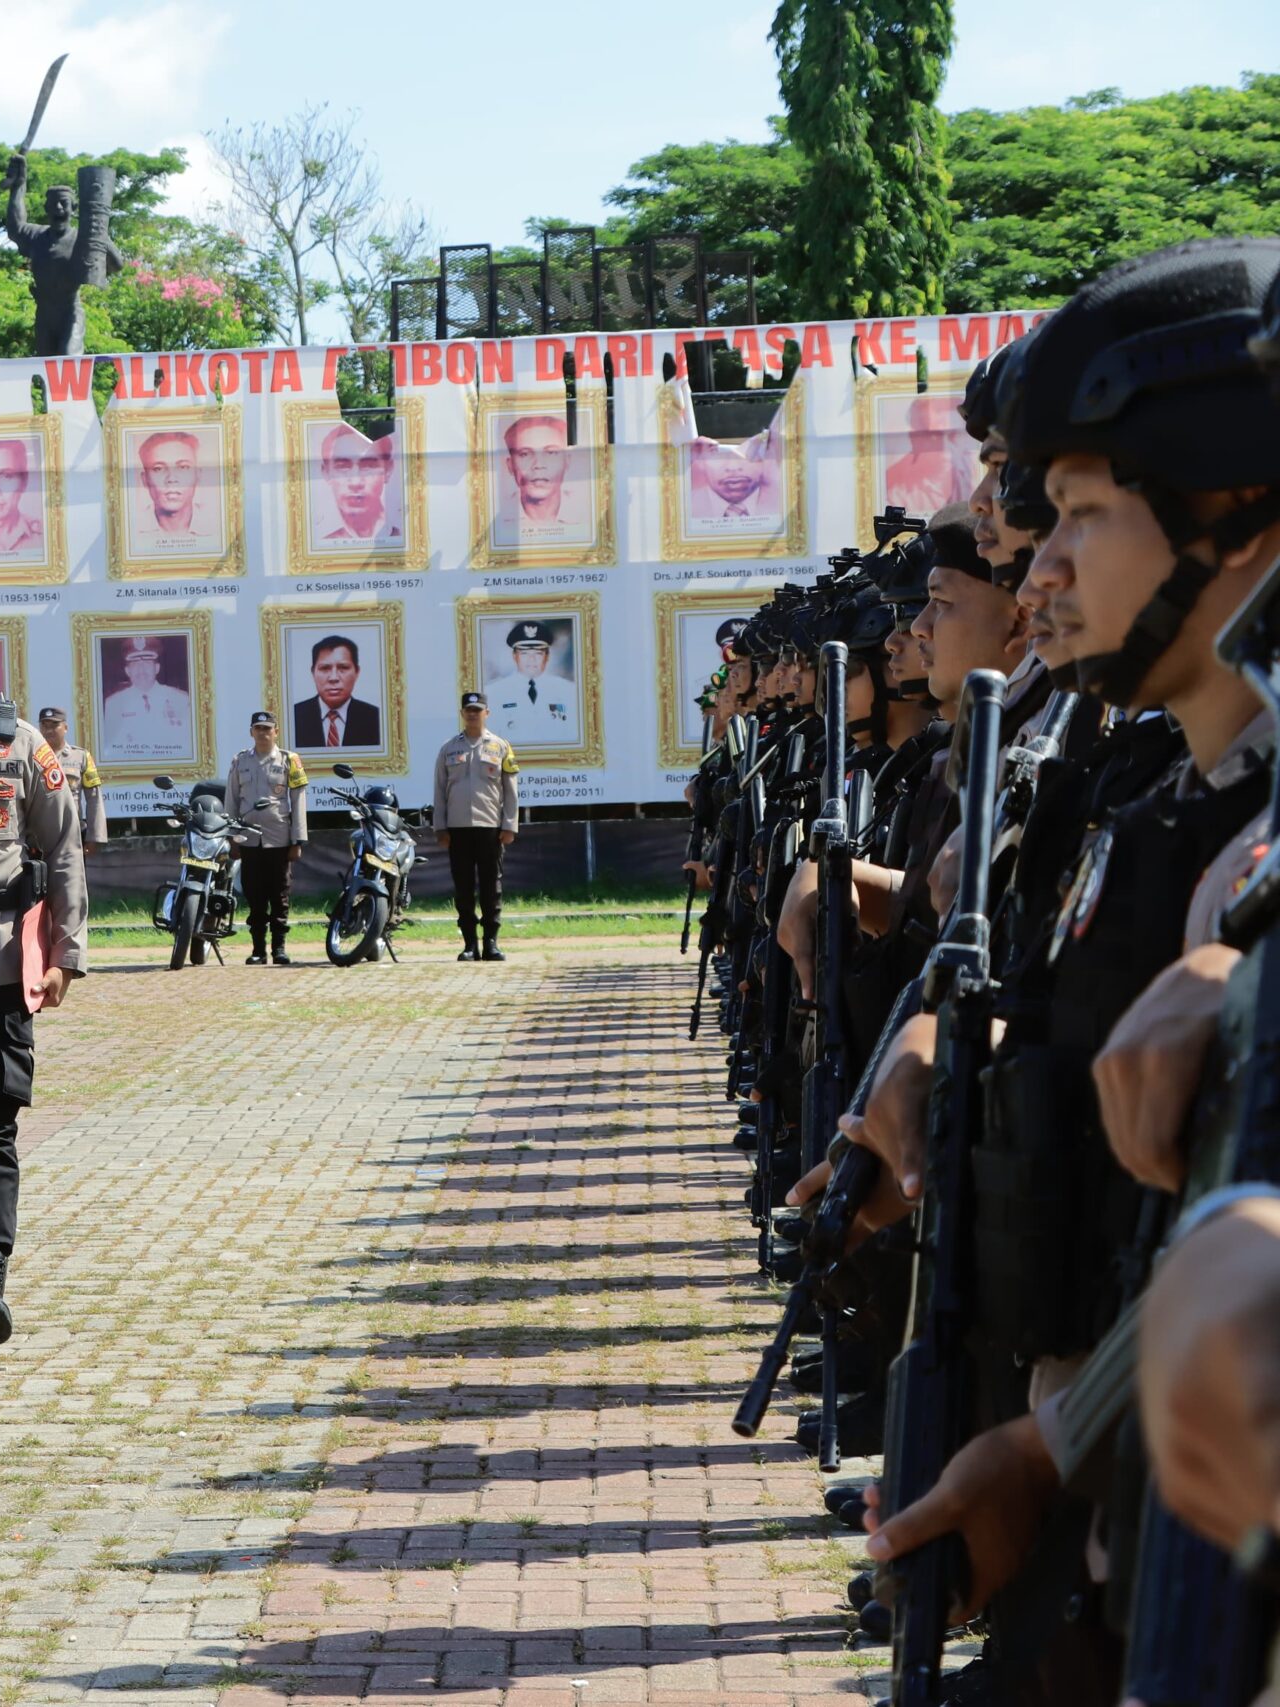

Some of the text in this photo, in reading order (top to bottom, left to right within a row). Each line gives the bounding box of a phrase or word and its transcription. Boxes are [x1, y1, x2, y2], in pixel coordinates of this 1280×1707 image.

[535, 333, 654, 382] DARI
[854, 319, 917, 365] KE
[504, 576, 544, 586] Sitanala
[546, 573, 607, 584] (1957-1962)
[653, 571, 673, 581] Drs.
[675, 570, 706, 580] J.M.E.
[707, 568, 752, 578] Soukotta
[116, 584, 240, 598] Z.M. Sitanala (1954-1956)
[315, 581, 360, 591] Soselissa
[362, 578, 424, 590] (1956-1957)
[1, 591, 60, 603] (1953-1954)
[528, 776, 570, 786] Papilaja,
[572, 774, 588, 783] MS
[112, 792, 132, 801] (Inf)
[134, 791, 159, 800] Chris
[542, 787, 604, 798] (2007-2011)
